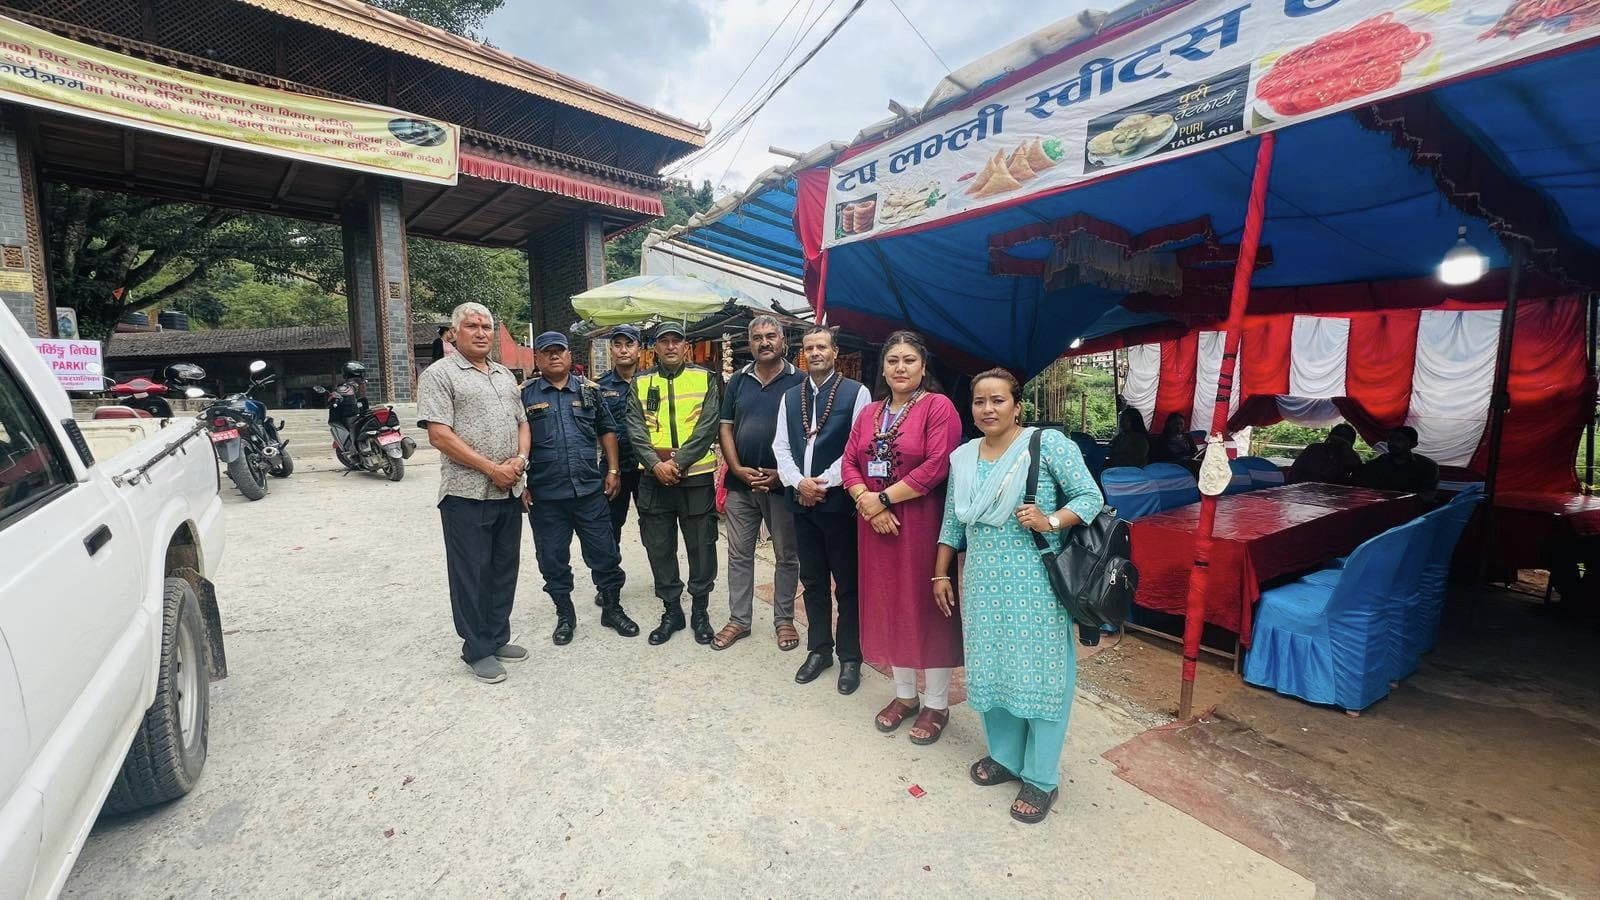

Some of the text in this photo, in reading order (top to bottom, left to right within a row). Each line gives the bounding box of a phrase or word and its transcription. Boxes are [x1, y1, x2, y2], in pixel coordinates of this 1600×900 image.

[77, 60, 139, 82] डोलेश्वर
[146, 78, 193, 95] महादेव
[199, 88, 245, 107] संरक्षण
[250, 103, 274, 115] तथा
[278, 105, 316, 122] विकास
[1170, 125, 1234, 149] TARKARI
[1180, 121, 1203, 137] PURI
